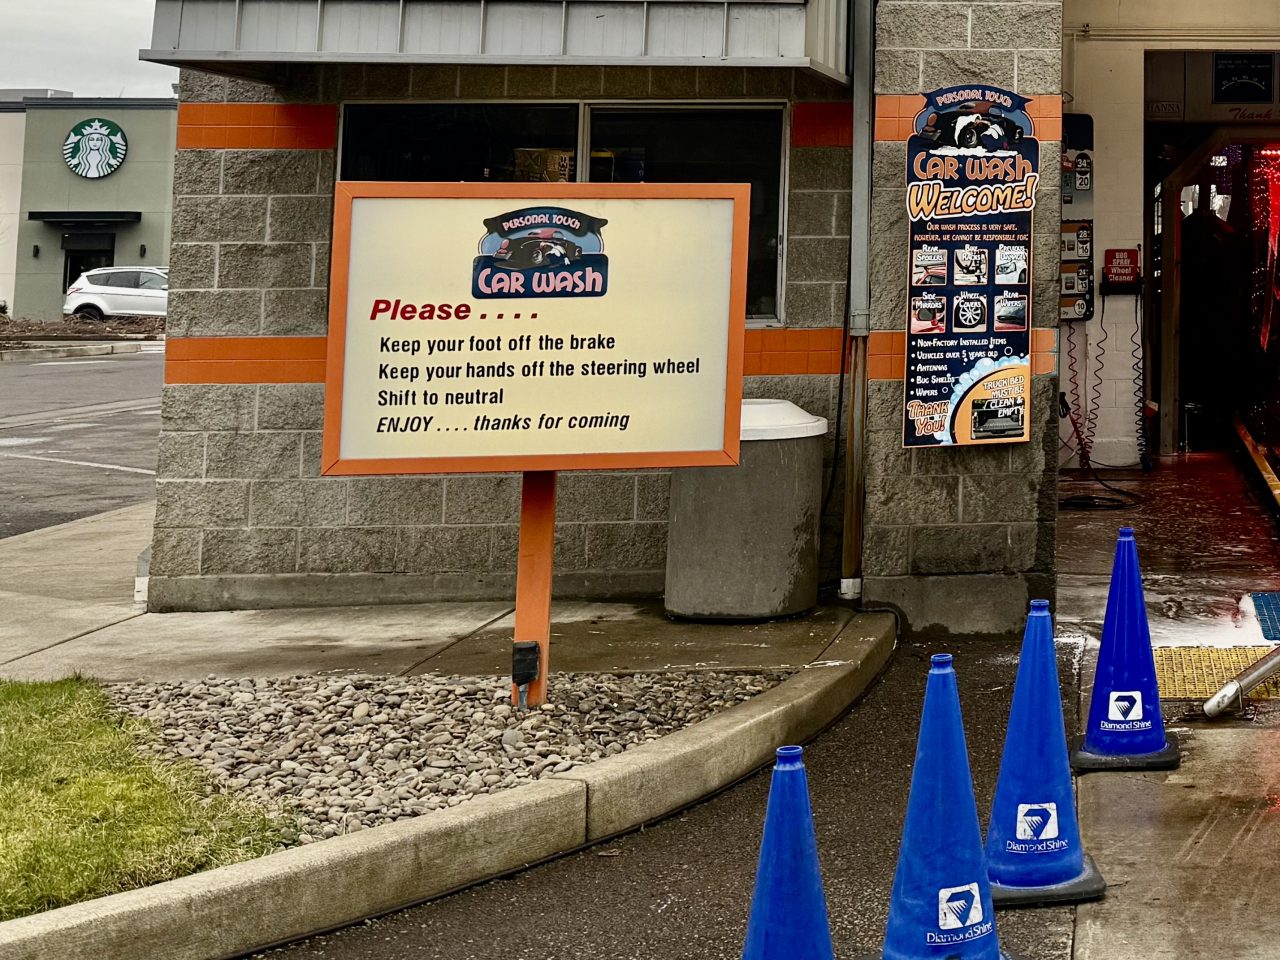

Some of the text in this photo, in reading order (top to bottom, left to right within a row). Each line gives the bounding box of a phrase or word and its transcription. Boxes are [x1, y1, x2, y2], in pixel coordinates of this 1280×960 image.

[936, 90, 982, 106] PERSONAL
[1228, 107, 1272, 119] Thank
[913, 152, 1032, 180] CAR WASH
[502, 213, 550, 231] PERSONAL
[477, 267, 603, 294] CAR WASH
[380, 334, 616, 355] Keep your foot off the brake
[962, 350, 967, 358] 5
[378, 357, 700, 381] Keep your hands off the steering wheel
[377, 388, 504, 407] Shift to neutral
[376, 415, 434, 433] ENJOY
[474, 413, 531, 431] thanks
[538, 413, 563, 430] for
[568, 412, 630, 430] coming
[1100, 720, 1132, 730] Diamond
[1006, 840, 1047, 852] Diamond
